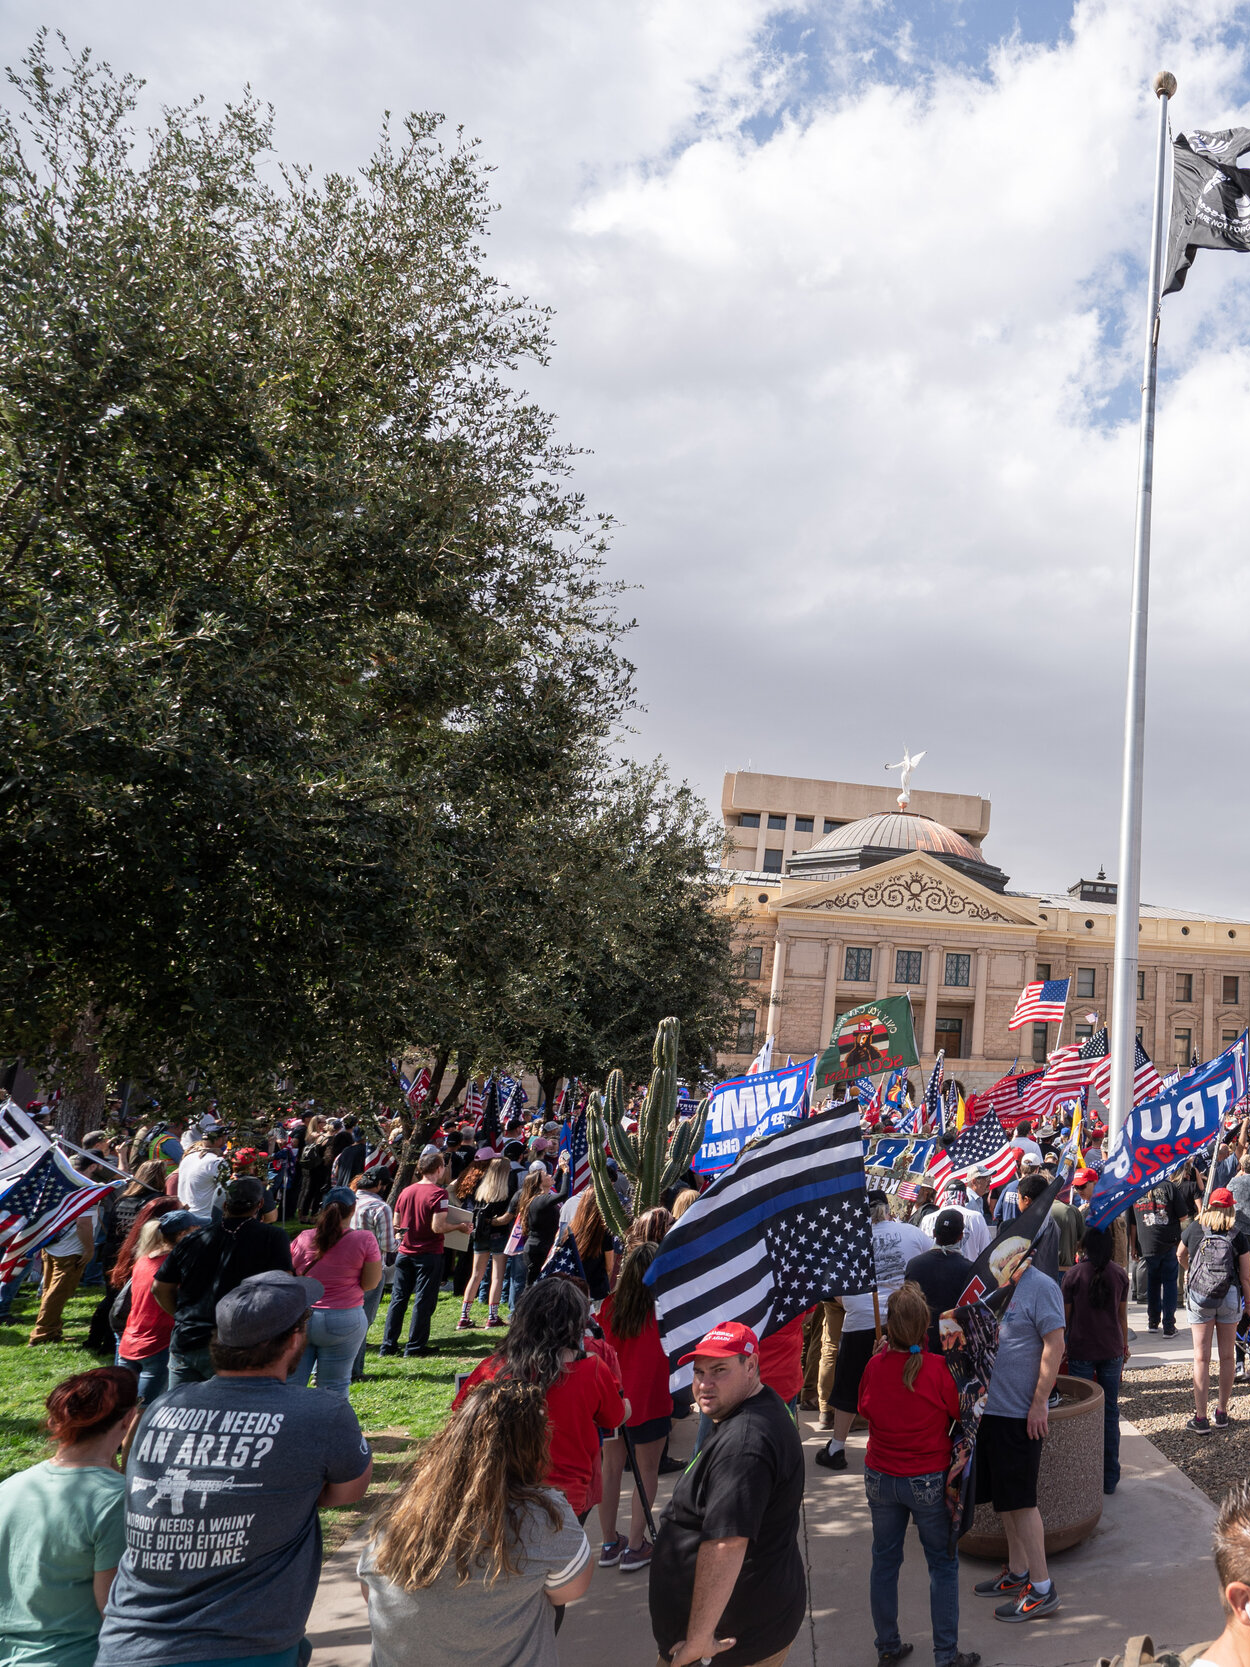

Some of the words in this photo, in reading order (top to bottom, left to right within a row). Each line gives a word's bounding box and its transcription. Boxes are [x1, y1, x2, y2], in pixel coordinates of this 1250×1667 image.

[1210, 220, 1228, 229] NOT
[860, 1079, 875, 1093] 2020
[148, 1406, 220, 1432] NOBODY
[218, 1410, 285, 1435] NEEDS
[136, 1430, 174, 1463] AN
[173, 1433, 274, 1468] AR15?
[127, 1514, 158, 1531] NOBODY
[159, 1518, 194, 1532] NEEDS
[197, 1519, 205, 1531] A
[210, 1513, 255, 1531] WHINY
[127, 1530, 152, 1550] LITTLE
[156, 1533, 191, 1550] BITCH
[196, 1530, 249, 1549] EITHER,
[141, 1552, 174, 1571] HERE
[180, 1551, 207, 1570] YOU
[211, 1547, 246, 1567] ARE.
